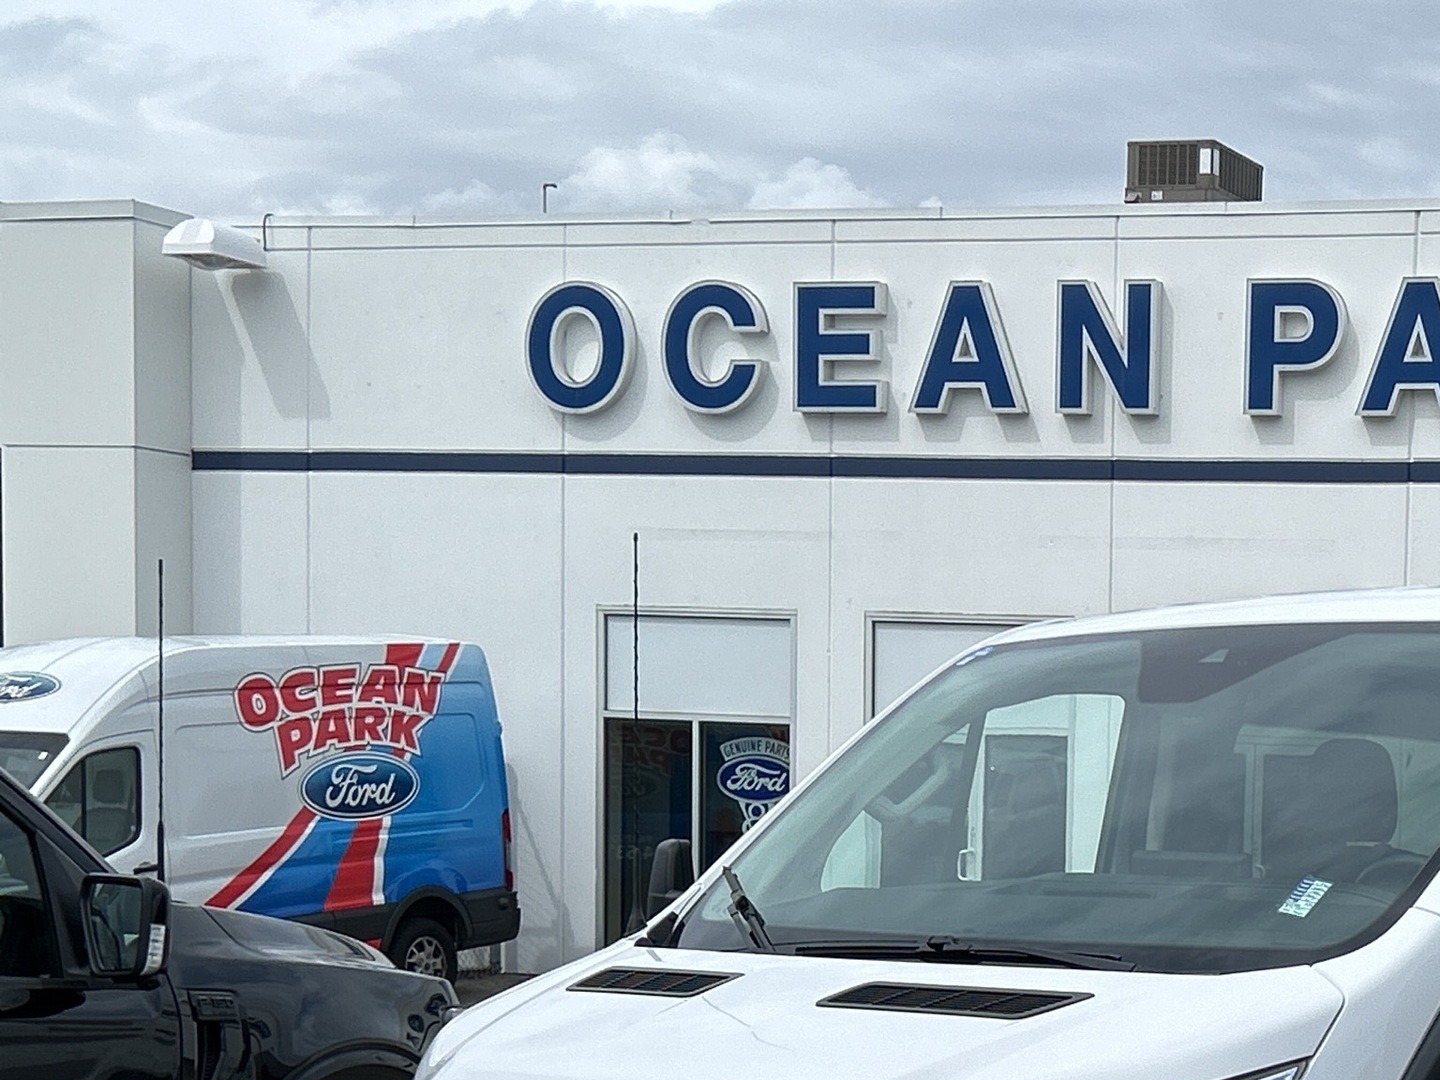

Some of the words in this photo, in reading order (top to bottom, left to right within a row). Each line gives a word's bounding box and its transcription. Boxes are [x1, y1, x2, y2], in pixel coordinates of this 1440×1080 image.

[525, 279, 1164, 415] OCEAN
[236, 664, 444, 730] OCEAN
[275, 706, 422, 778] PARK
[723, 740, 762, 758] GENUINE
[325, 764, 396, 807] Ford
[726, 763, 788, 791] Ford
